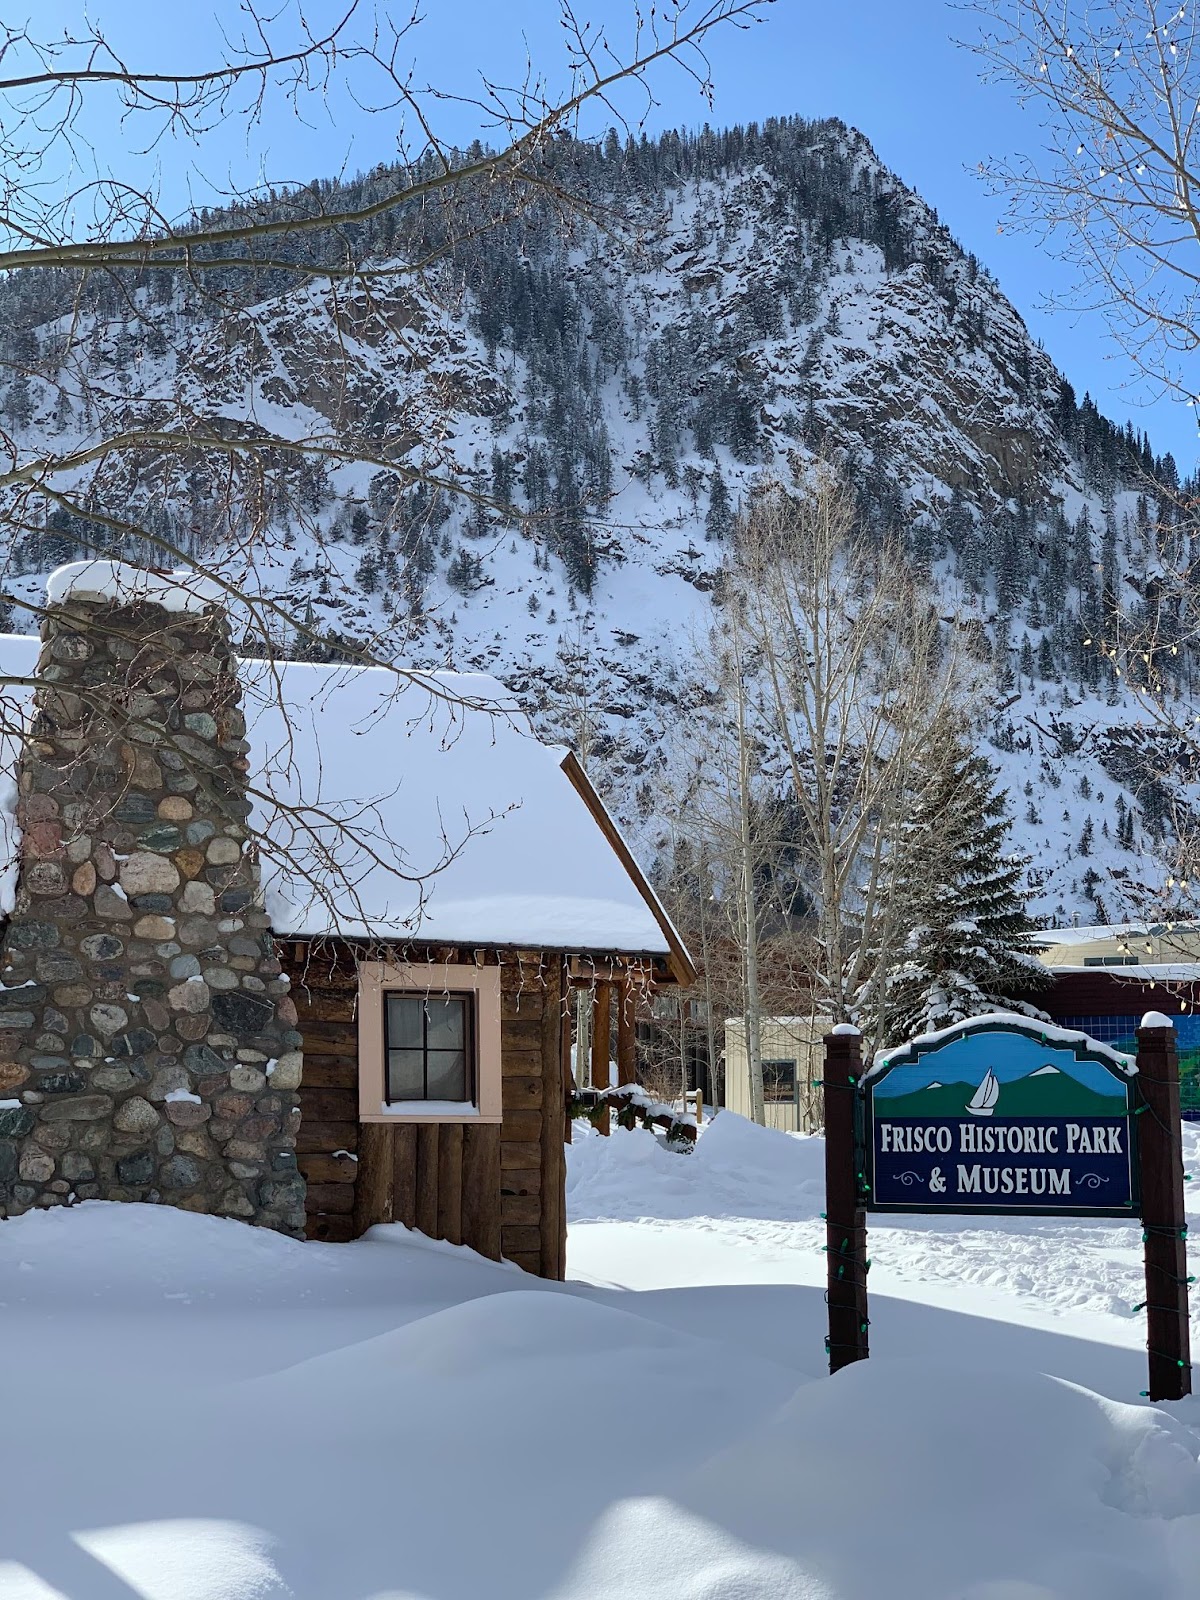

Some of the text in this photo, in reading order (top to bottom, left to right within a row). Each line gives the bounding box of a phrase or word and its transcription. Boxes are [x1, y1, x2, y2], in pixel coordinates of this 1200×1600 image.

[880, 1123, 1123, 1154] FRISCO HISTORIC PARK
[928, 1164, 1072, 1195] & MUSEUM
